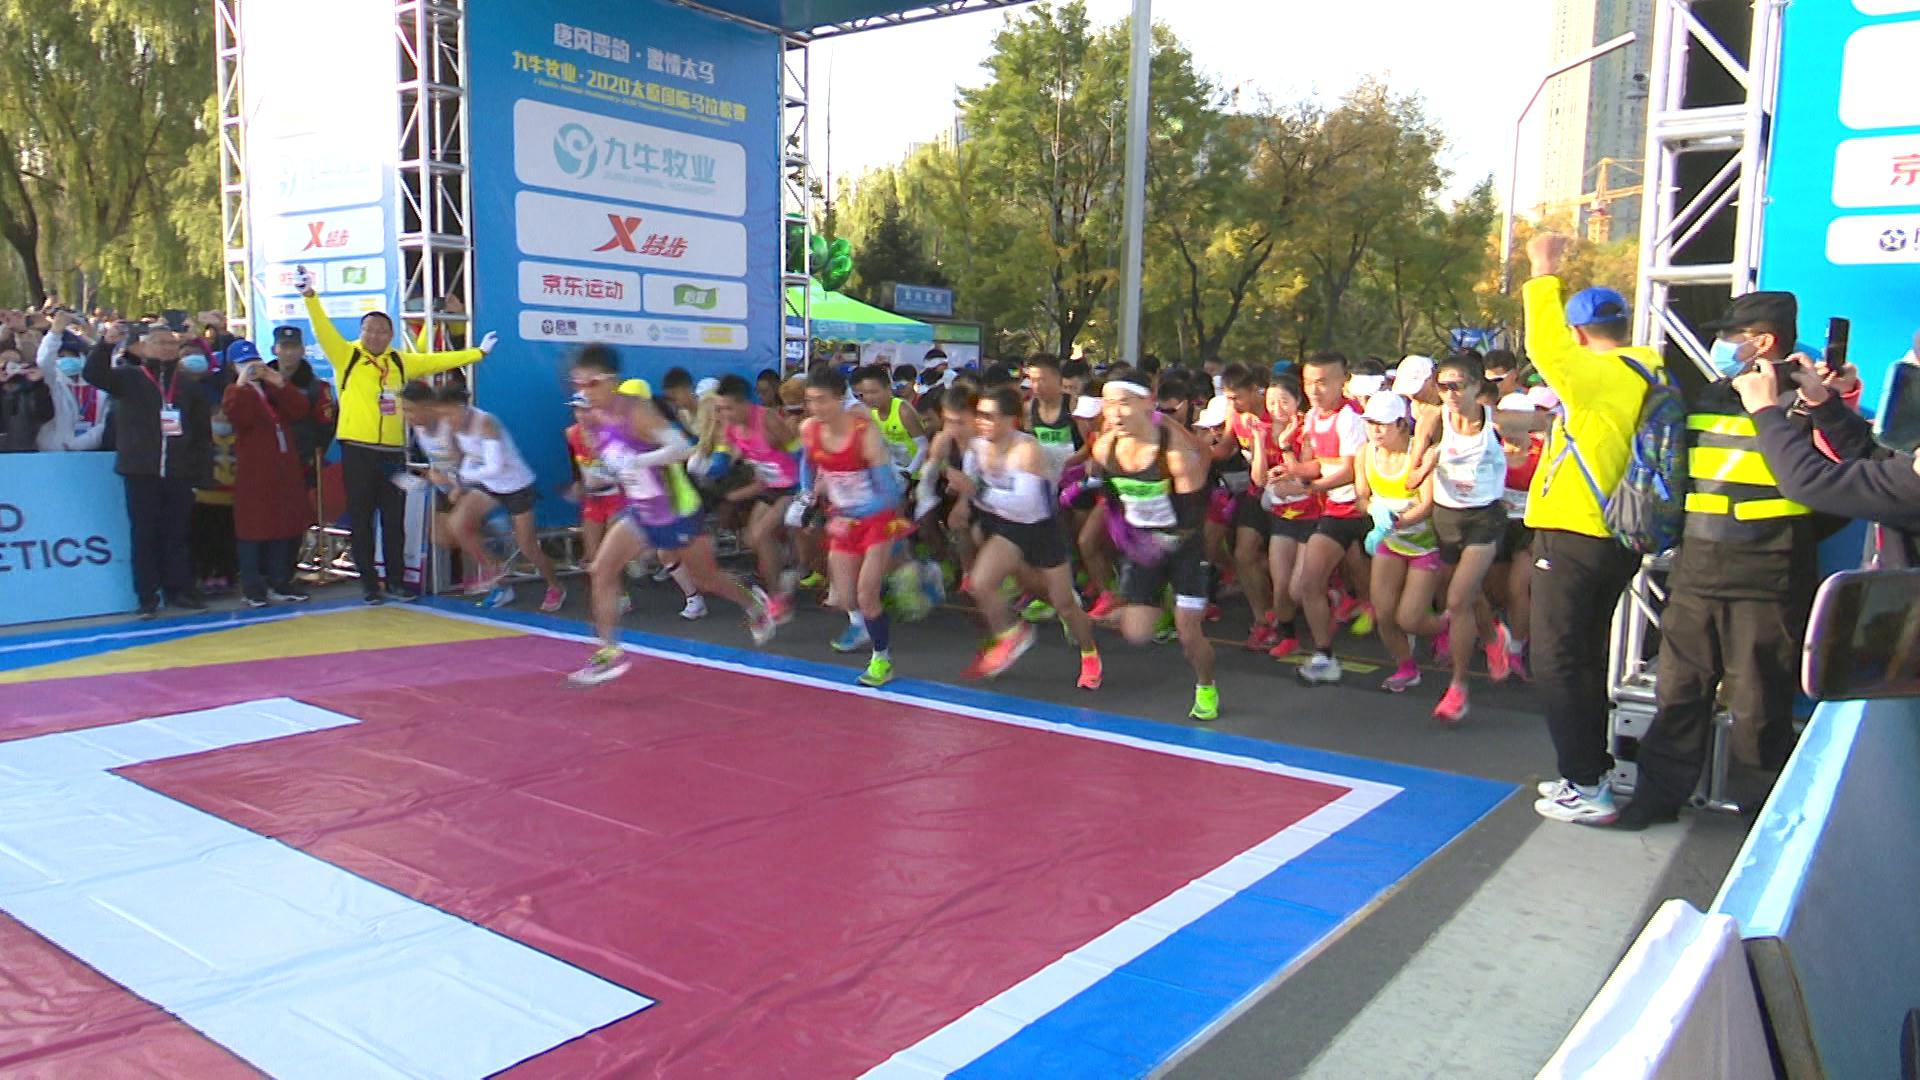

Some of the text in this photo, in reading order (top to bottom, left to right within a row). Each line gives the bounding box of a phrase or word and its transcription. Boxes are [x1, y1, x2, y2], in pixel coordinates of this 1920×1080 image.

[604, 137, 716, 184] 九牛牧业
[542, 275, 624, 299] 京东运动
